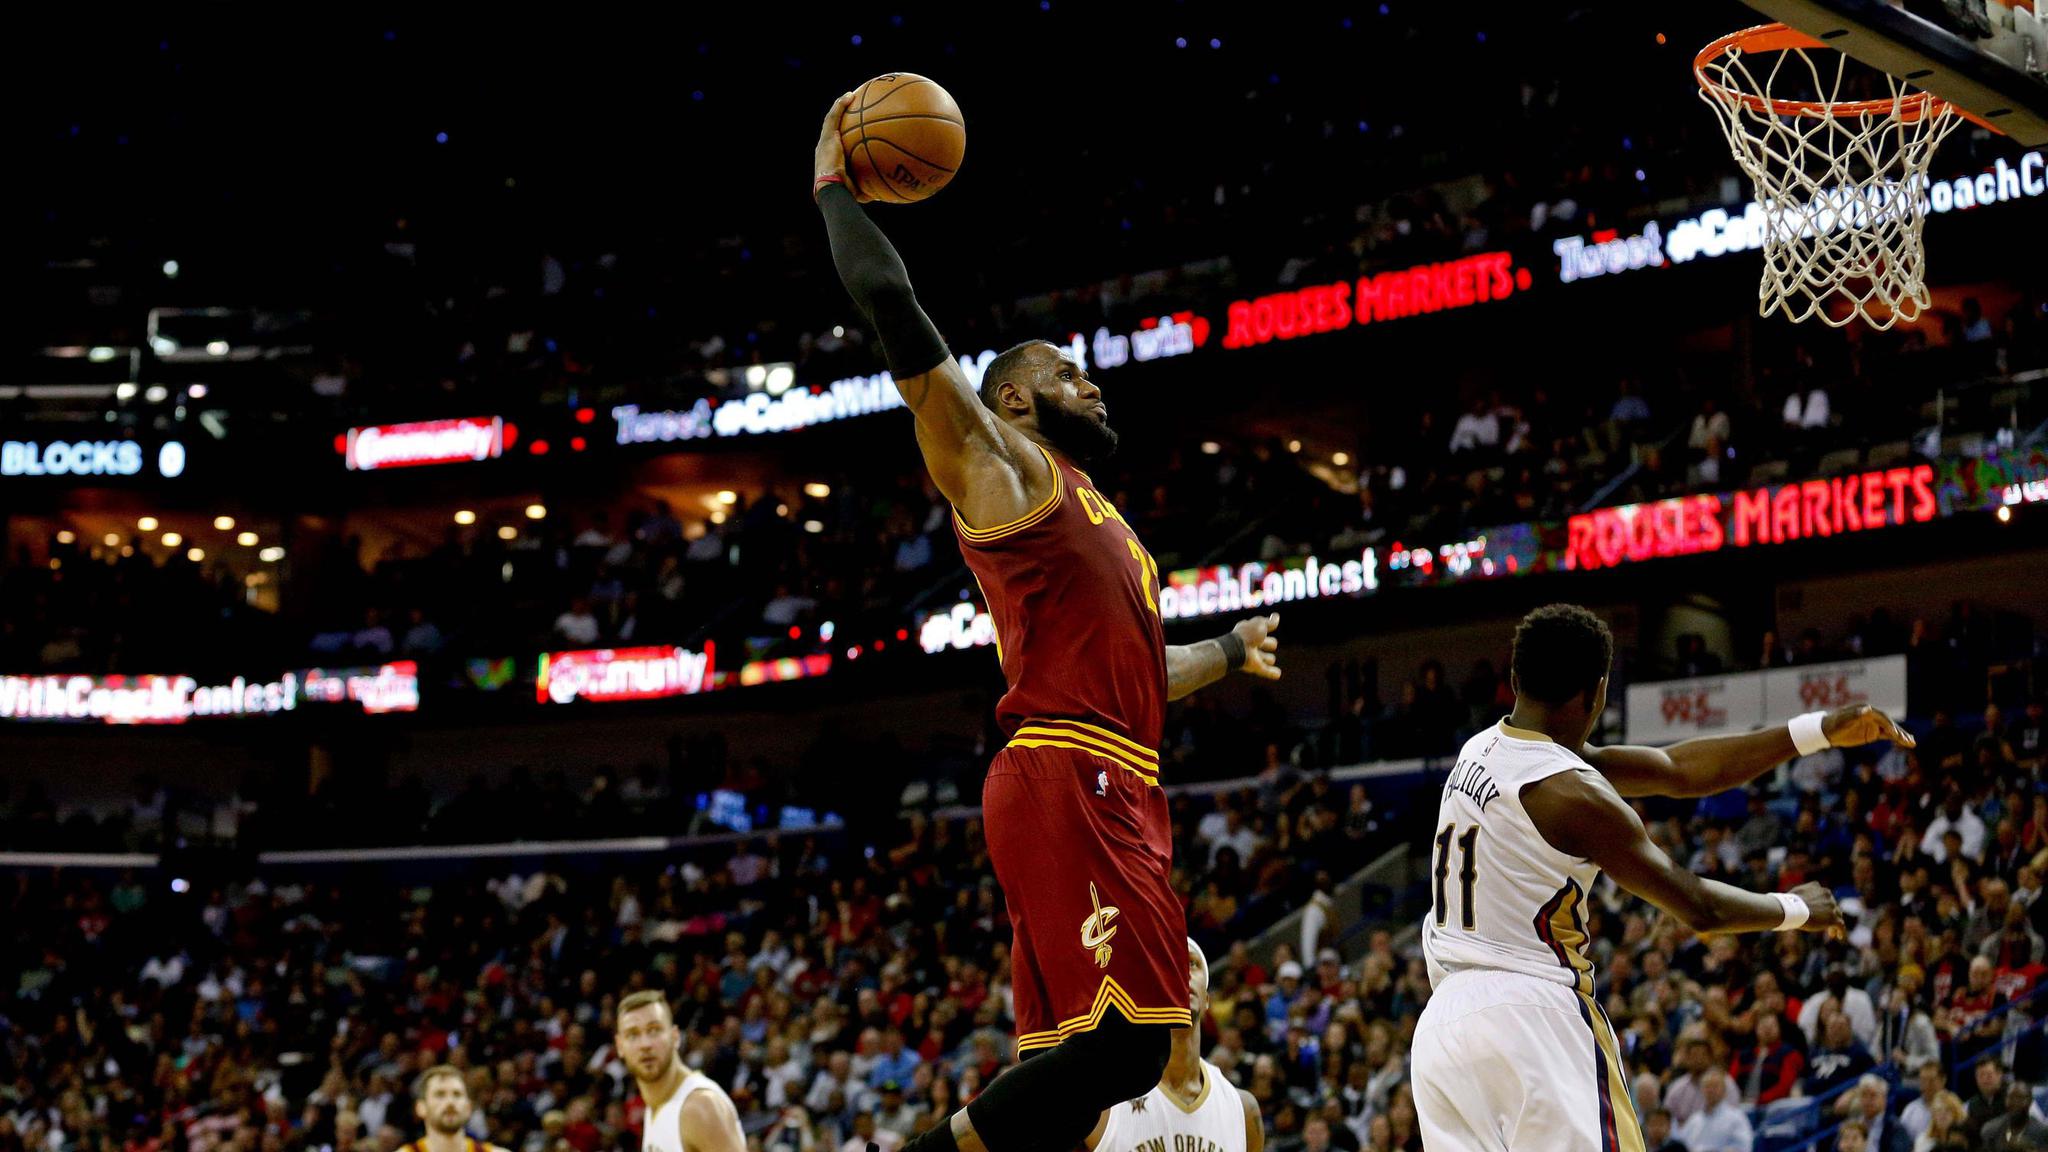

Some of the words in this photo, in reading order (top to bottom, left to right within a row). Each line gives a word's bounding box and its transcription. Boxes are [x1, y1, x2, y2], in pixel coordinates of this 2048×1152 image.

[1222, 281, 1351, 349] ROUSES
[1356, 251, 1513, 324] MARKETS
[1, 440, 143, 476] BLOCKS
[158, 441, 186, 478] 0
[1565, 494, 1723, 570] ROUSES
[1734, 465, 1936, 547] MARKETS
[1435, 822, 1480, 932] 11
